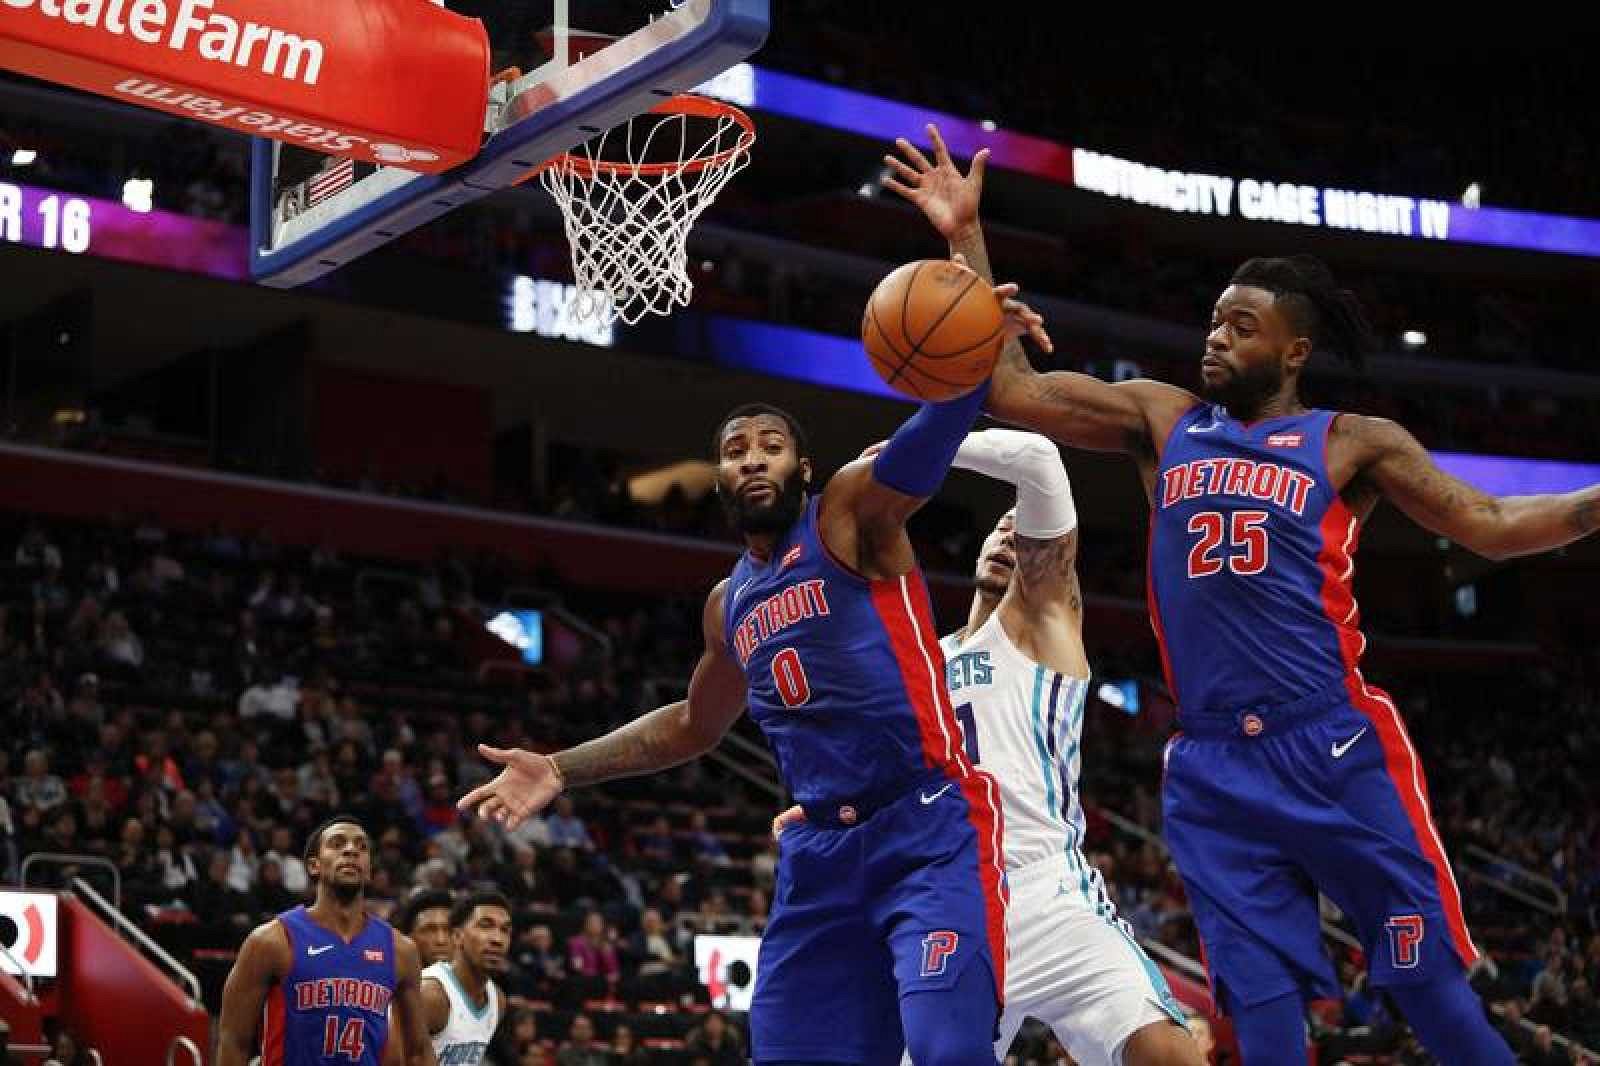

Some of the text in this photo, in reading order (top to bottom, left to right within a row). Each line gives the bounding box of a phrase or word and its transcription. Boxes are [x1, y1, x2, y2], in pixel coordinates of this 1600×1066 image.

[0, 0, 323, 84] ateFarm
[38, 194, 91, 254] 16
[1161, 458, 1316, 516] DETROIT
[1186, 510, 1269, 579] 25
[733, 578, 831, 666] DETROIT
[771, 647, 811, 710] 0
[323, 1015, 365, 1062] 14
